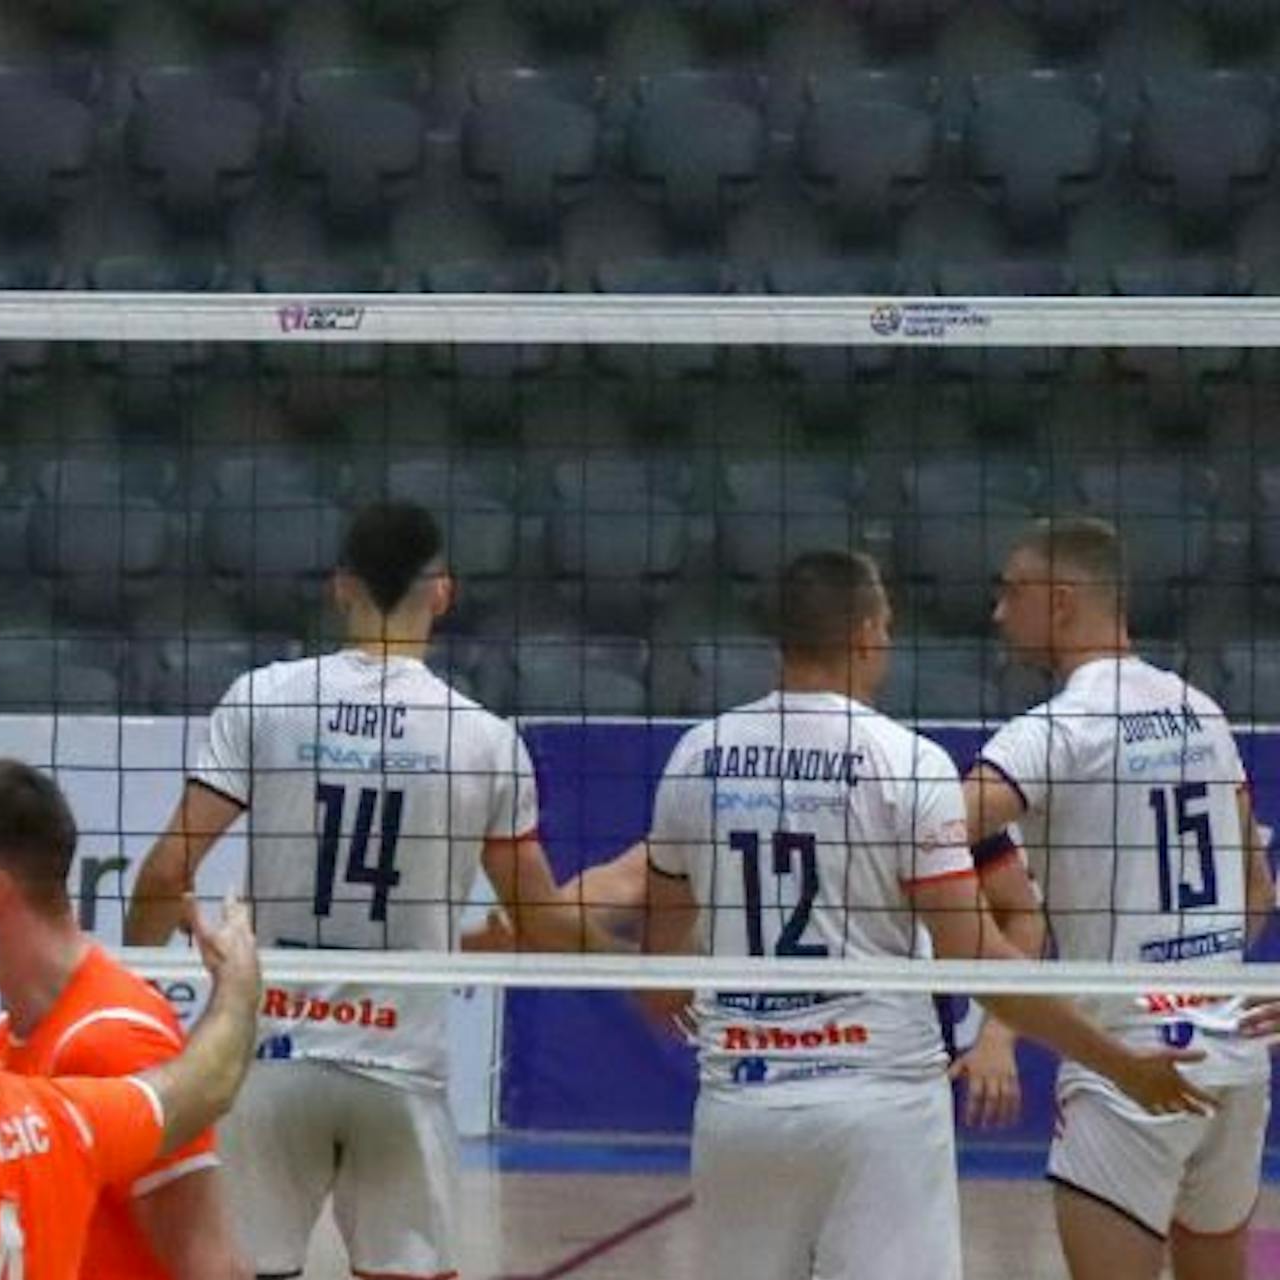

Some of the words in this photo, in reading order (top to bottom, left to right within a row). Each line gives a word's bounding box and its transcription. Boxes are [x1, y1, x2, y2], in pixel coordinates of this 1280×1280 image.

[313, 781, 404, 922] 14
[729, 830, 829, 958] 12
[1148, 781, 1219, 914] 15
[263, 988, 397, 1029] Ribola
[725, 1020, 868, 1050] Ribola
